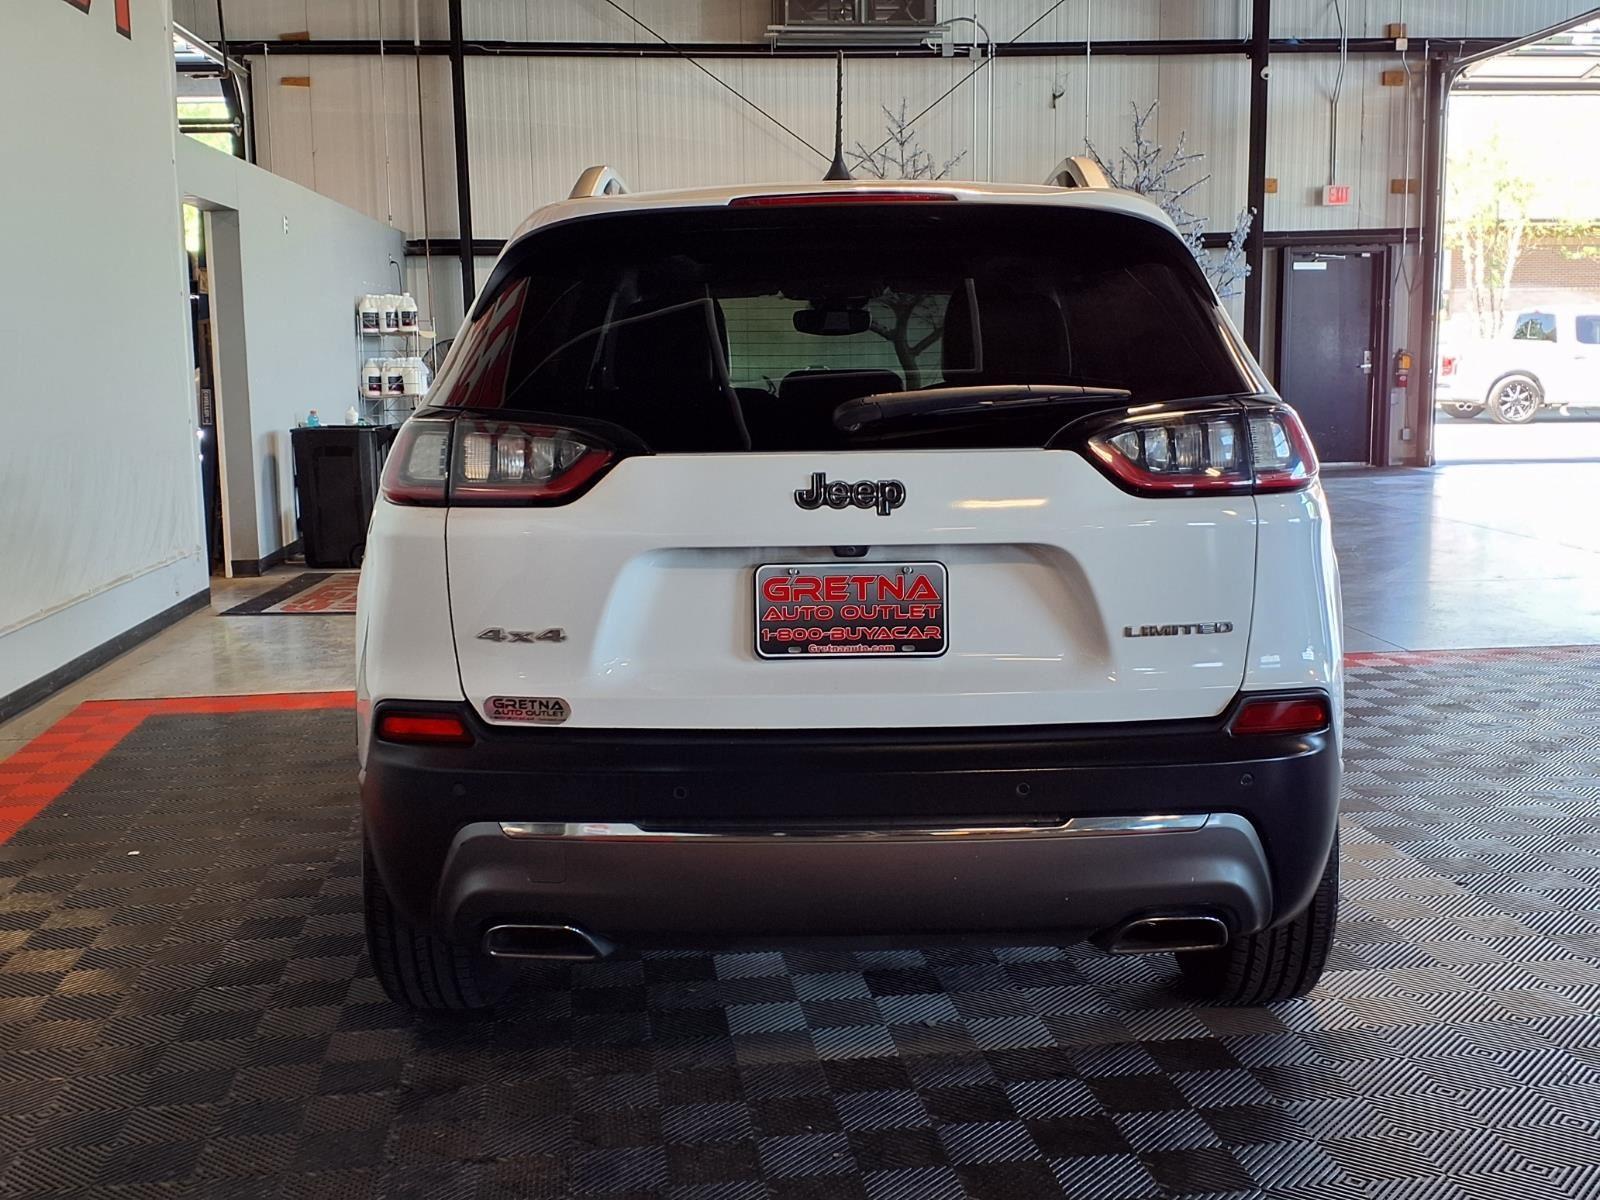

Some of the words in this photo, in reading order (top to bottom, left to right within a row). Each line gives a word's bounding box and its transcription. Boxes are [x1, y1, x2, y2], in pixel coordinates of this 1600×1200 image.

[794, 472, 906, 516] Jeep
[762, 574, 941, 602] GRETNA
[761, 605, 834, 622] AUTO
[840, 603, 942, 620] OUTLET
[477, 627, 567, 643] 4x4
[761, 626, 942, 642] 1-800-BUYACAR
[1123, 621, 1234, 637] LIMITED
[808, 643, 896, 654] Gretnaauto.com
[492, 699, 564, 711] GRETNA
